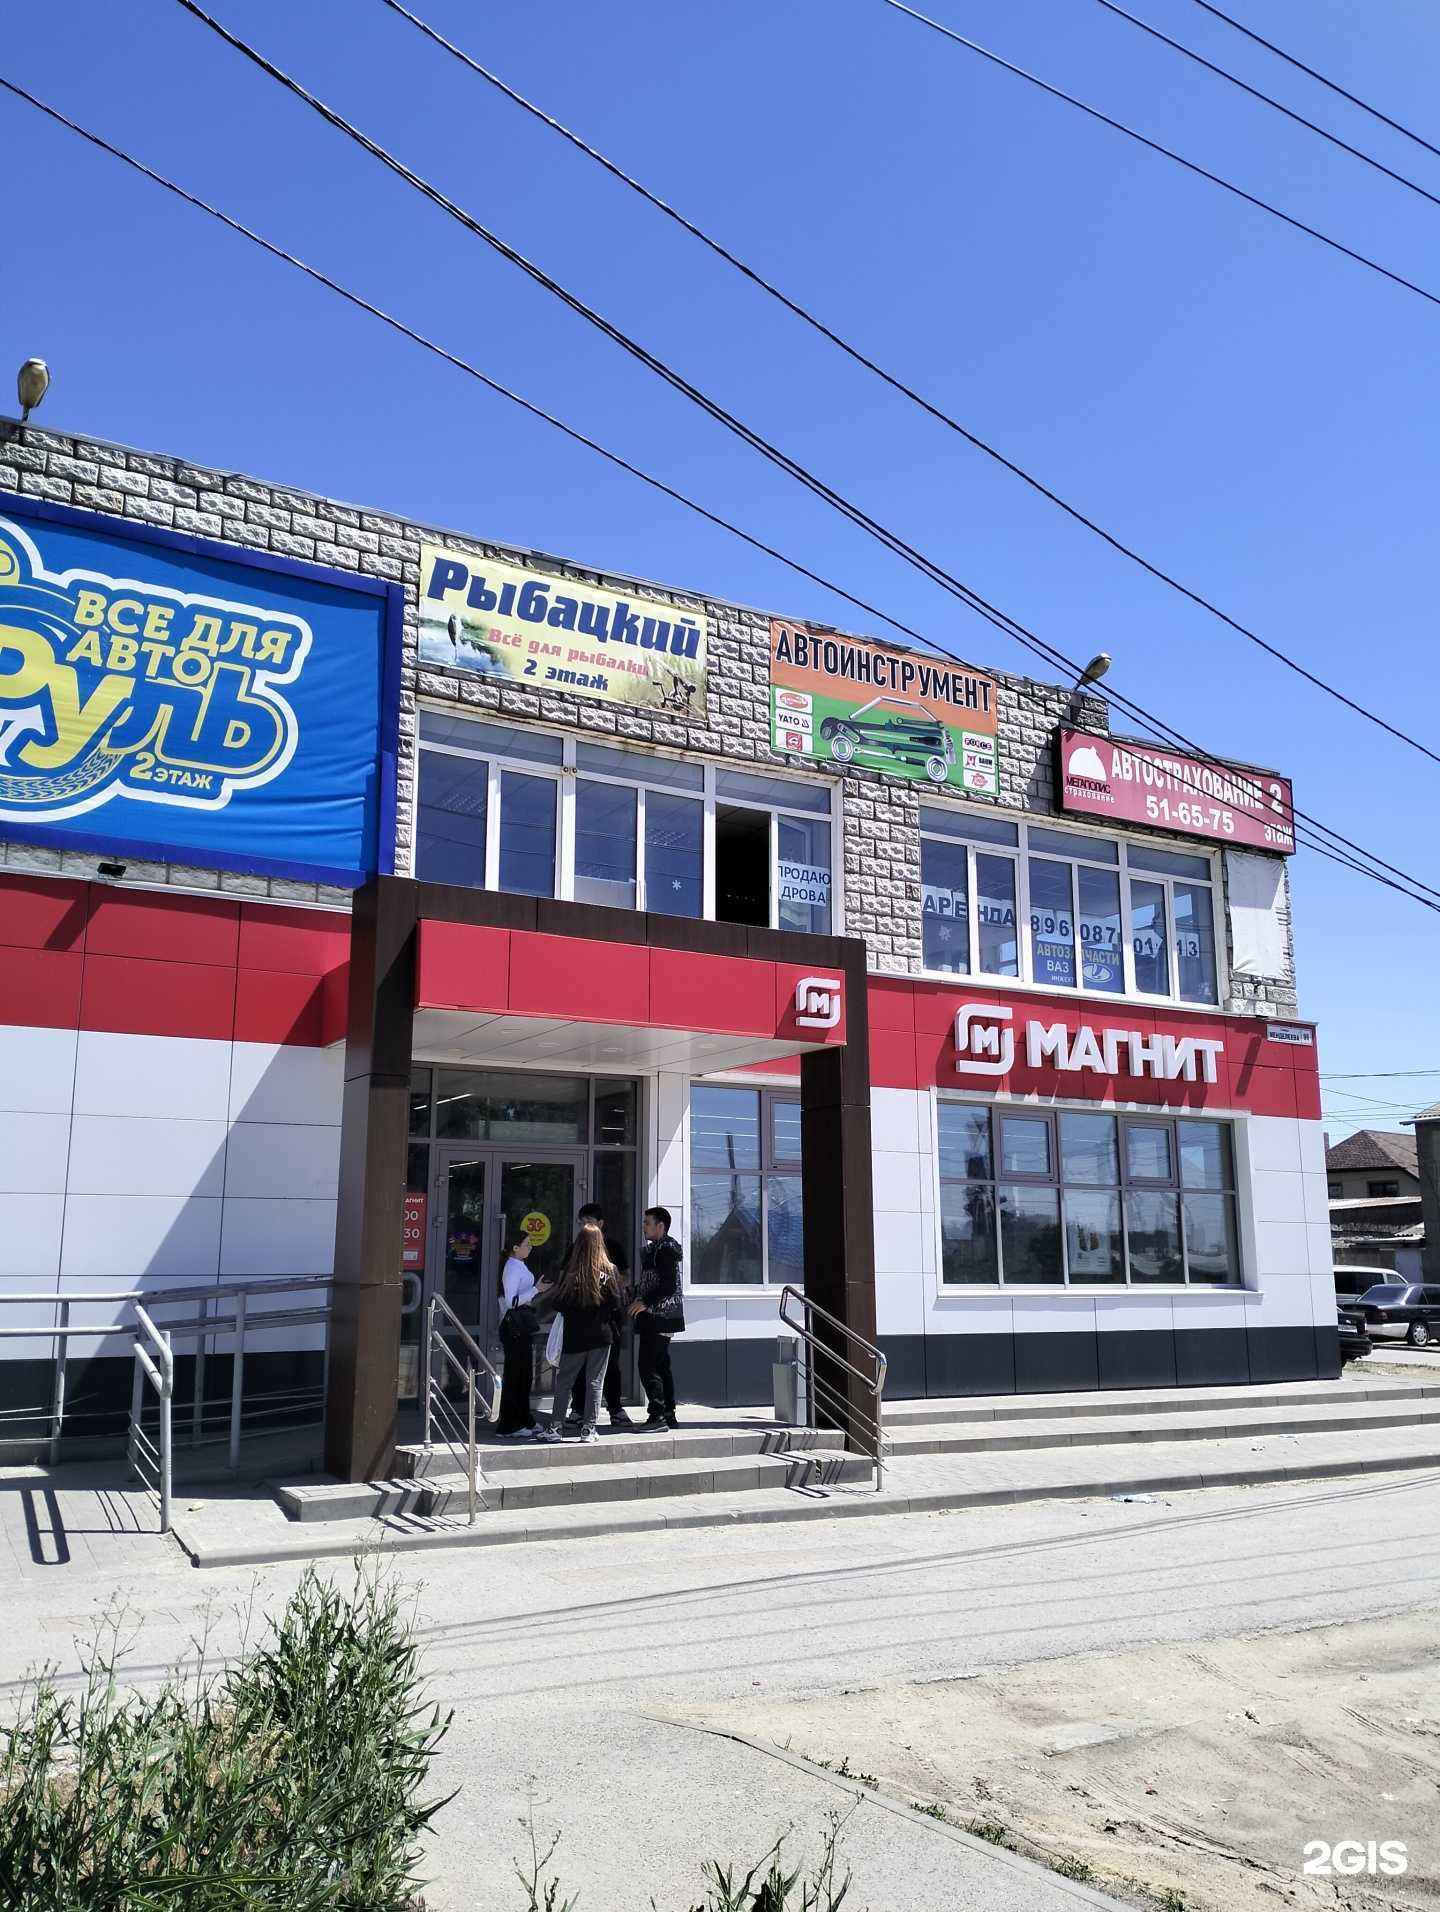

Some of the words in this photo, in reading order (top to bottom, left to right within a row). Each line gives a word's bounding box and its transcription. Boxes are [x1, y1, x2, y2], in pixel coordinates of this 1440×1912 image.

[74, 590, 174, 640] ВСЕ
[181, 614, 292, 663] ДЛЯ
[427, 556, 701, 660] Рыбацкий
[66, 631, 211, 684] АВТО
[487, 628, 522, 647] Всё
[527, 641, 562, 657] для
[567, 649, 649, 676] рыбалки
[774, 629, 993, 713] АВТОИНСТРУМЕНТ
[523, 658, 538, 676] 2
[545, 666, 609, 692] этаж
[778, 713, 800, 726] YATO
[129, 753, 153, 780] 2
[153, 770, 215, 790] ЭТАЖ
[1111, 749, 1264, 811] АВТОСТРАХОВАНИЕ
[1269, 783, 1284, 815] 2
[1146, 795, 1235, 833] 51-65-75
[781, 886, 826, 903] ДРОВА
[923, 894, 1016, 928] АРЕНДА
[1047, 960, 1070, 974] ВАЗ
[1026, 1020, 1224, 1083] МАГНИТ
